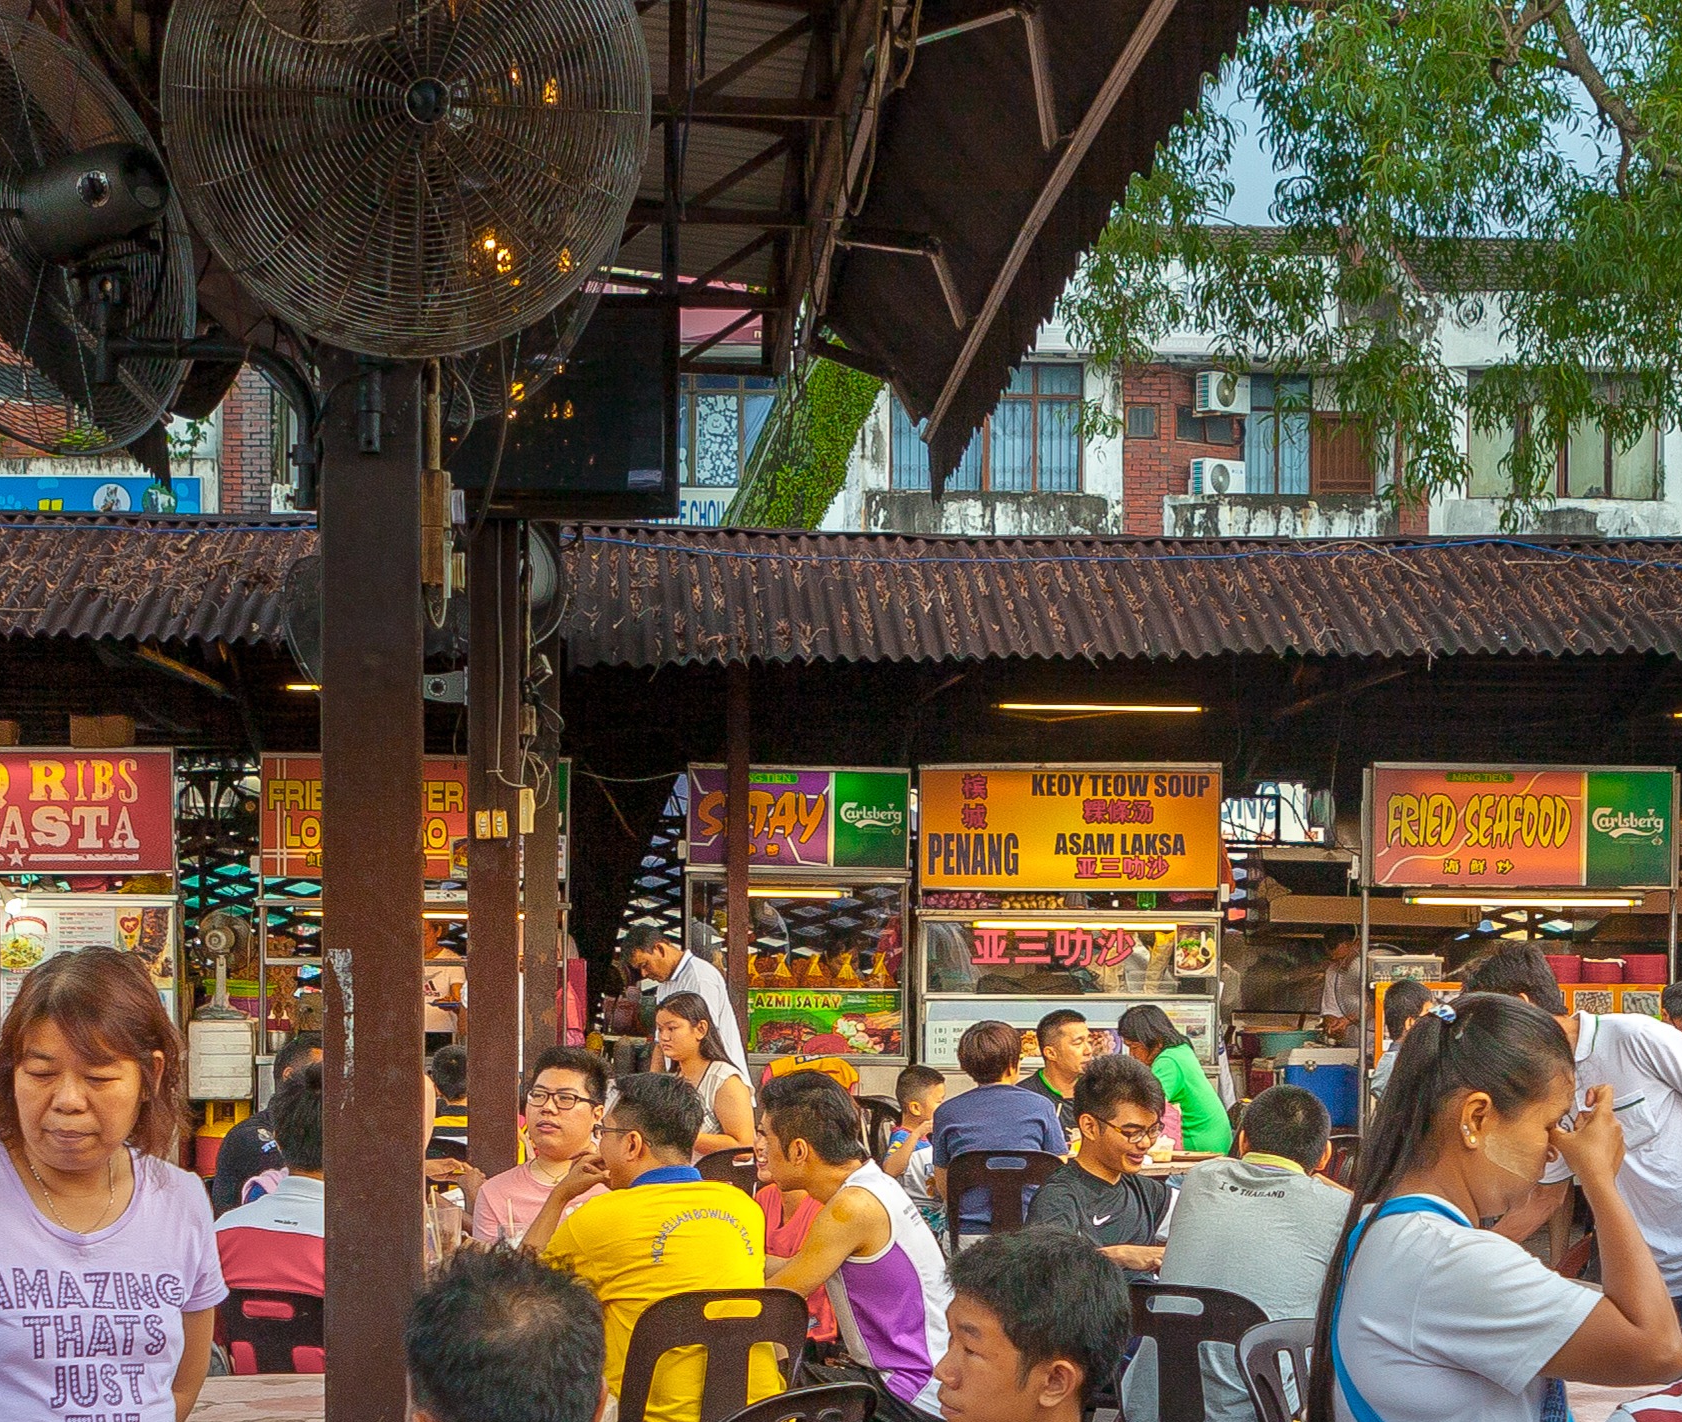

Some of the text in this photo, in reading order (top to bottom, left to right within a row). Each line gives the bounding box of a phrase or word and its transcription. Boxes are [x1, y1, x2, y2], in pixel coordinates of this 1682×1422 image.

[28, 757, 139, 803] RIBS
[268, 779, 322, 811] FRIE
[1032, 774, 1210, 798] KEOY TEOW SOUP
[840, 802, 902, 829] Carlsberg
[1386, 792, 1665, 849] FRIED SEAFOOD Carlsberg
[928, 832, 1019, 877] PENANG
[1054, 832, 1186, 856] ASAM LAKSA
[971, 927, 1137, 968] 亚三叻沙
[754, 993, 792, 1009] AZMI
[796, 994, 842, 1009] SATAY
[1239, 1188, 1286, 1199] THAILAND
[22, 1313, 167, 1360] THATS
[50, 1363, 145, 1410] JUST
